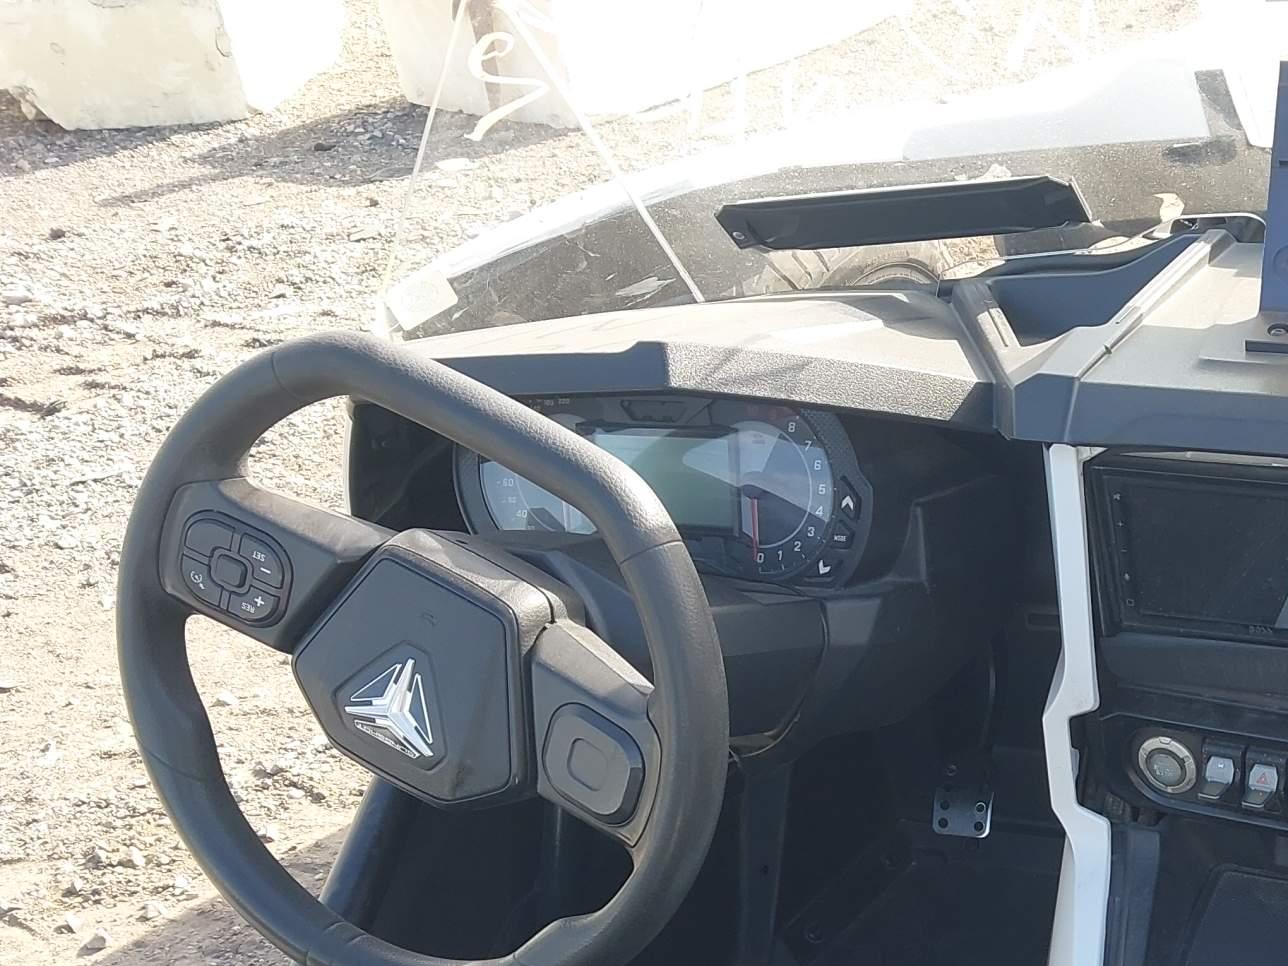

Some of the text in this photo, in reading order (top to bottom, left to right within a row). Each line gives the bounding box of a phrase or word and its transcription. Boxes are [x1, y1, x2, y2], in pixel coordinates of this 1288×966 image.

[788, 422, 796, 433] 8
[805, 441, 812, 451] 7
[814, 460, 822, 471] 6
[818, 484, 826, 495] 5
[815, 506, 824, 516] 4
[807, 526, 815, 537] 3
[794, 541, 802, 552] 2
[252, 551, 266, 562] SET
[757, 553, 764, 563] 0
[777, 550, 783, 561] 1
[241, 602, 256, 613] RES
